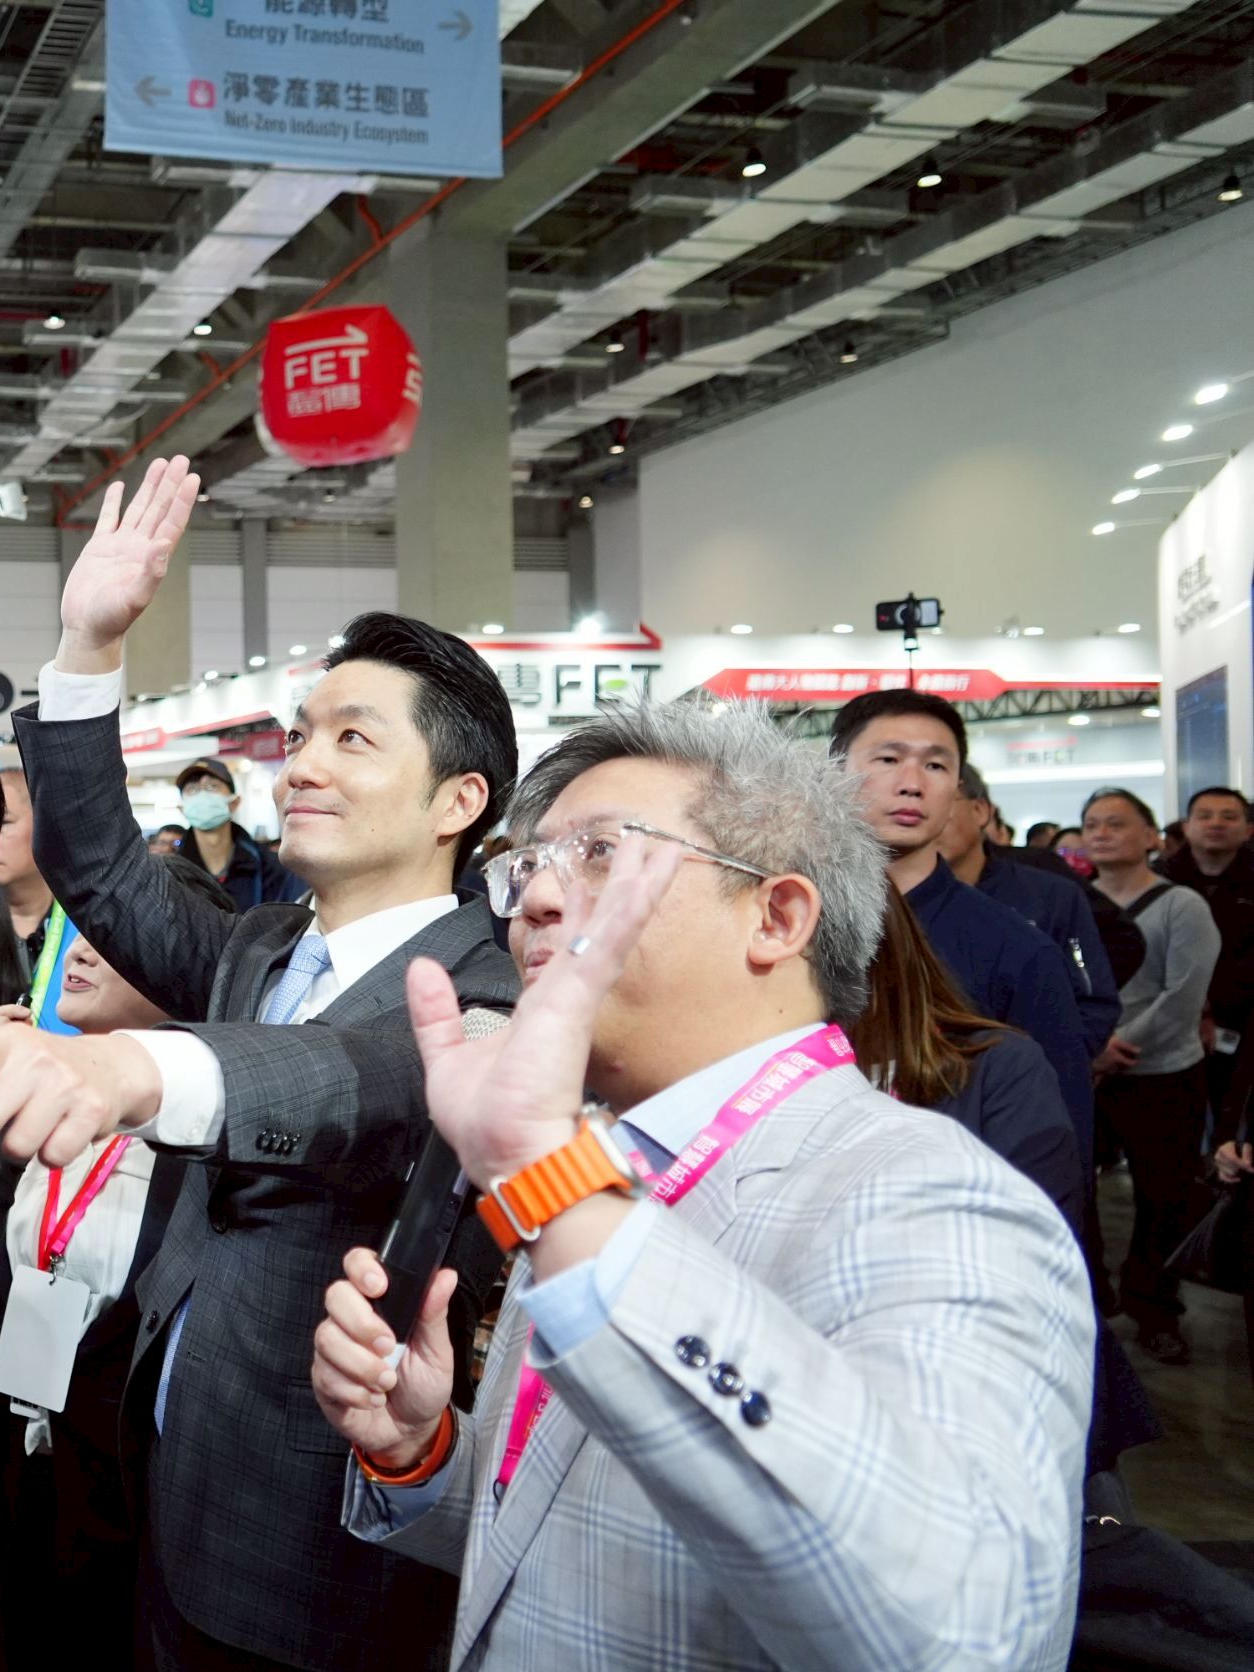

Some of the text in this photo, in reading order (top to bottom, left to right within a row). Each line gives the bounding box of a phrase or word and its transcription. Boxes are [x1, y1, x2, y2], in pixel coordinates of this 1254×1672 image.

[225, 19, 426, 54] Energy Transformation
[223, 71, 430, 118] 淨零產業生態區
[224, 110, 430, 146] Net-Zero Industry Ecosystem
[284, 347, 370, 390] FET
